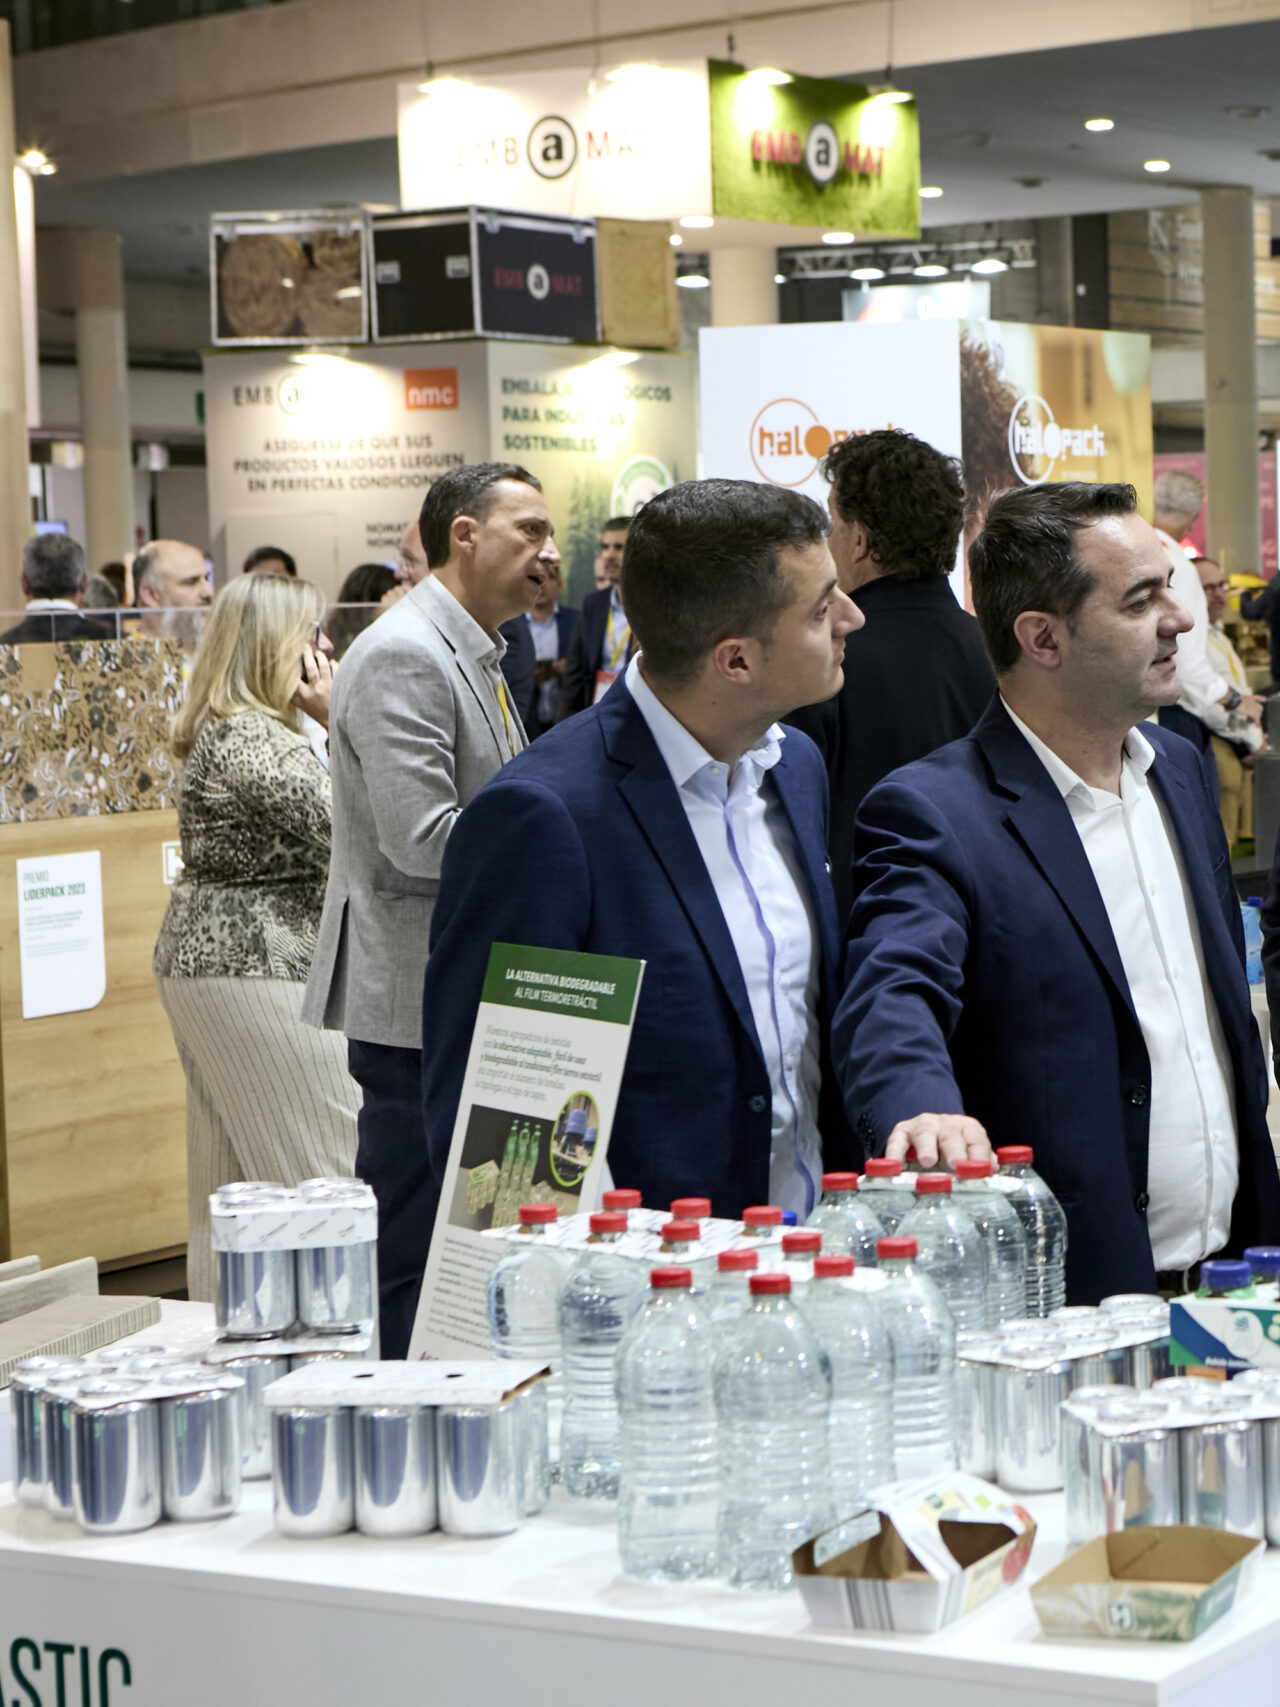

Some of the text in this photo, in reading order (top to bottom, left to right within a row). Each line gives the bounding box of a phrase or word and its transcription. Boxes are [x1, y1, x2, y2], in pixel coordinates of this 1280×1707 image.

[751, 130, 801, 164] EMB
[844, 141, 885, 174] MAT
[233, 385, 274, 406] EMB
[408, 386, 455, 407] nmc
[503, 406, 540, 422] PARA
[370, 436, 400, 449] QUE
[406, 434, 433, 448] SUS
[503, 433, 598, 452] SOSTENIBLES
[234, 453, 466, 473] PRODUCTOS VALIOSOS LLEGUEN
[248, 479, 266, 492] EN
[272, 477, 344, 491] PERFECTAS
[23, 870, 49, 885] PREMIO
[23, 884, 66, 901] LIDERPACK
[505, 967, 616, 995] LA ALTERNATIVA BIODEGRADABLE
[514, 986, 599, 1010] AL FILM TERMORETRÁCTIL
[0, 1636, 131, 1707] STIC
